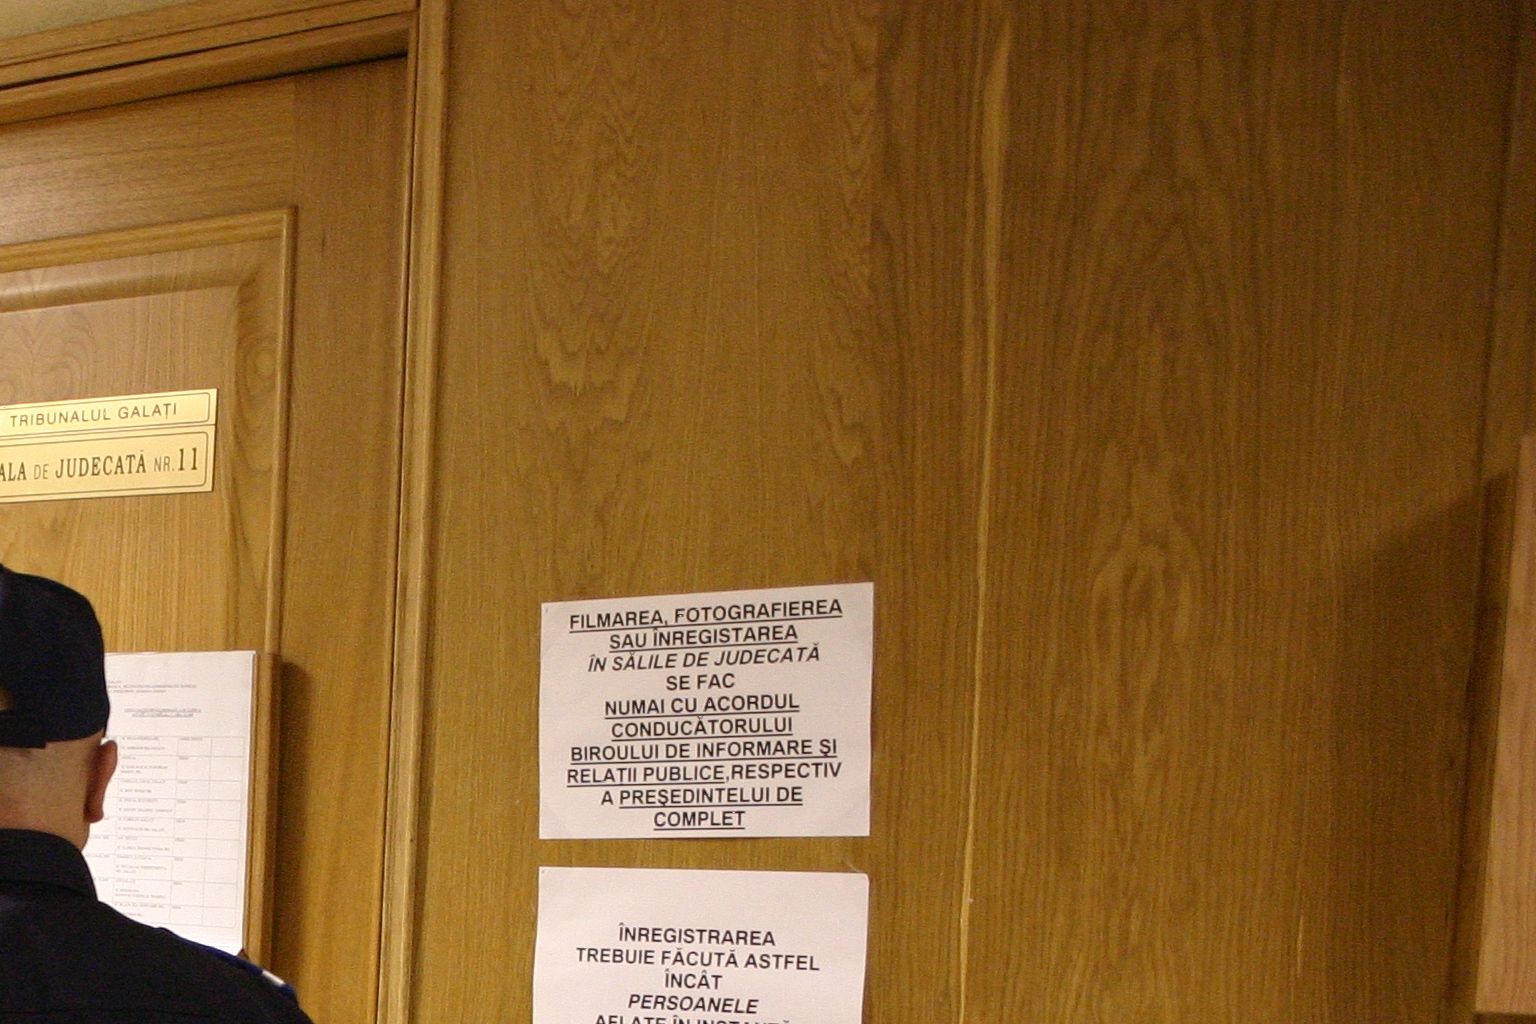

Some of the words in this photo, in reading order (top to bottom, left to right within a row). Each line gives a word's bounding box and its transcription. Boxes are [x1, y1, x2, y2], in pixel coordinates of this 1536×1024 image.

[10, 408, 110, 427] TRIBUNALUL
[34, 463, 49, 480] DE
[55, 449, 146, 479] JUDECATĂ
[178, 447, 197, 471] 11
[570, 610, 668, 629] FILMAREA,
[675, 599, 842, 623] FOTOGRAFIEREA
[609, 633, 647, 649] SAU
[653, 625, 798, 647] ÎNREGISTAREA
[588, 654, 607, 672] ÎN
[612, 651, 678, 671] SĂLILE
[683, 652, 710, 667] DE
[714, 642, 820, 666] JUDECATĂ
[666, 675, 691, 691] SE
[697, 673, 735, 690] FAC
[605, 699, 664, 716] NUMAI
[671, 697, 697, 713] CU
[703, 693, 800, 712] ACORDUL
[611, 715, 792, 738] CONDUCĂTORULUI
[571, 743, 659, 761] BIROULUI
[665, 743, 690, 759] DE
[697, 739, 813, 758] INFORMARE
[601, 789, 614, 805] A
[777, 786, 803, 802] DE
[654, 810, 746, 827] COMPLET
[619, 922, 776, 946] ÎNREGISTRAREA
[576, 947, 655, 964] TREBUIE
[661, 947, 739, 968] FĂCUTĂ
[744, 953, 820, 971] ASTFEL
[664, 968, 723, 990] ÎNCÂT
[628, 994, 760, 1014] PERSOANELE
